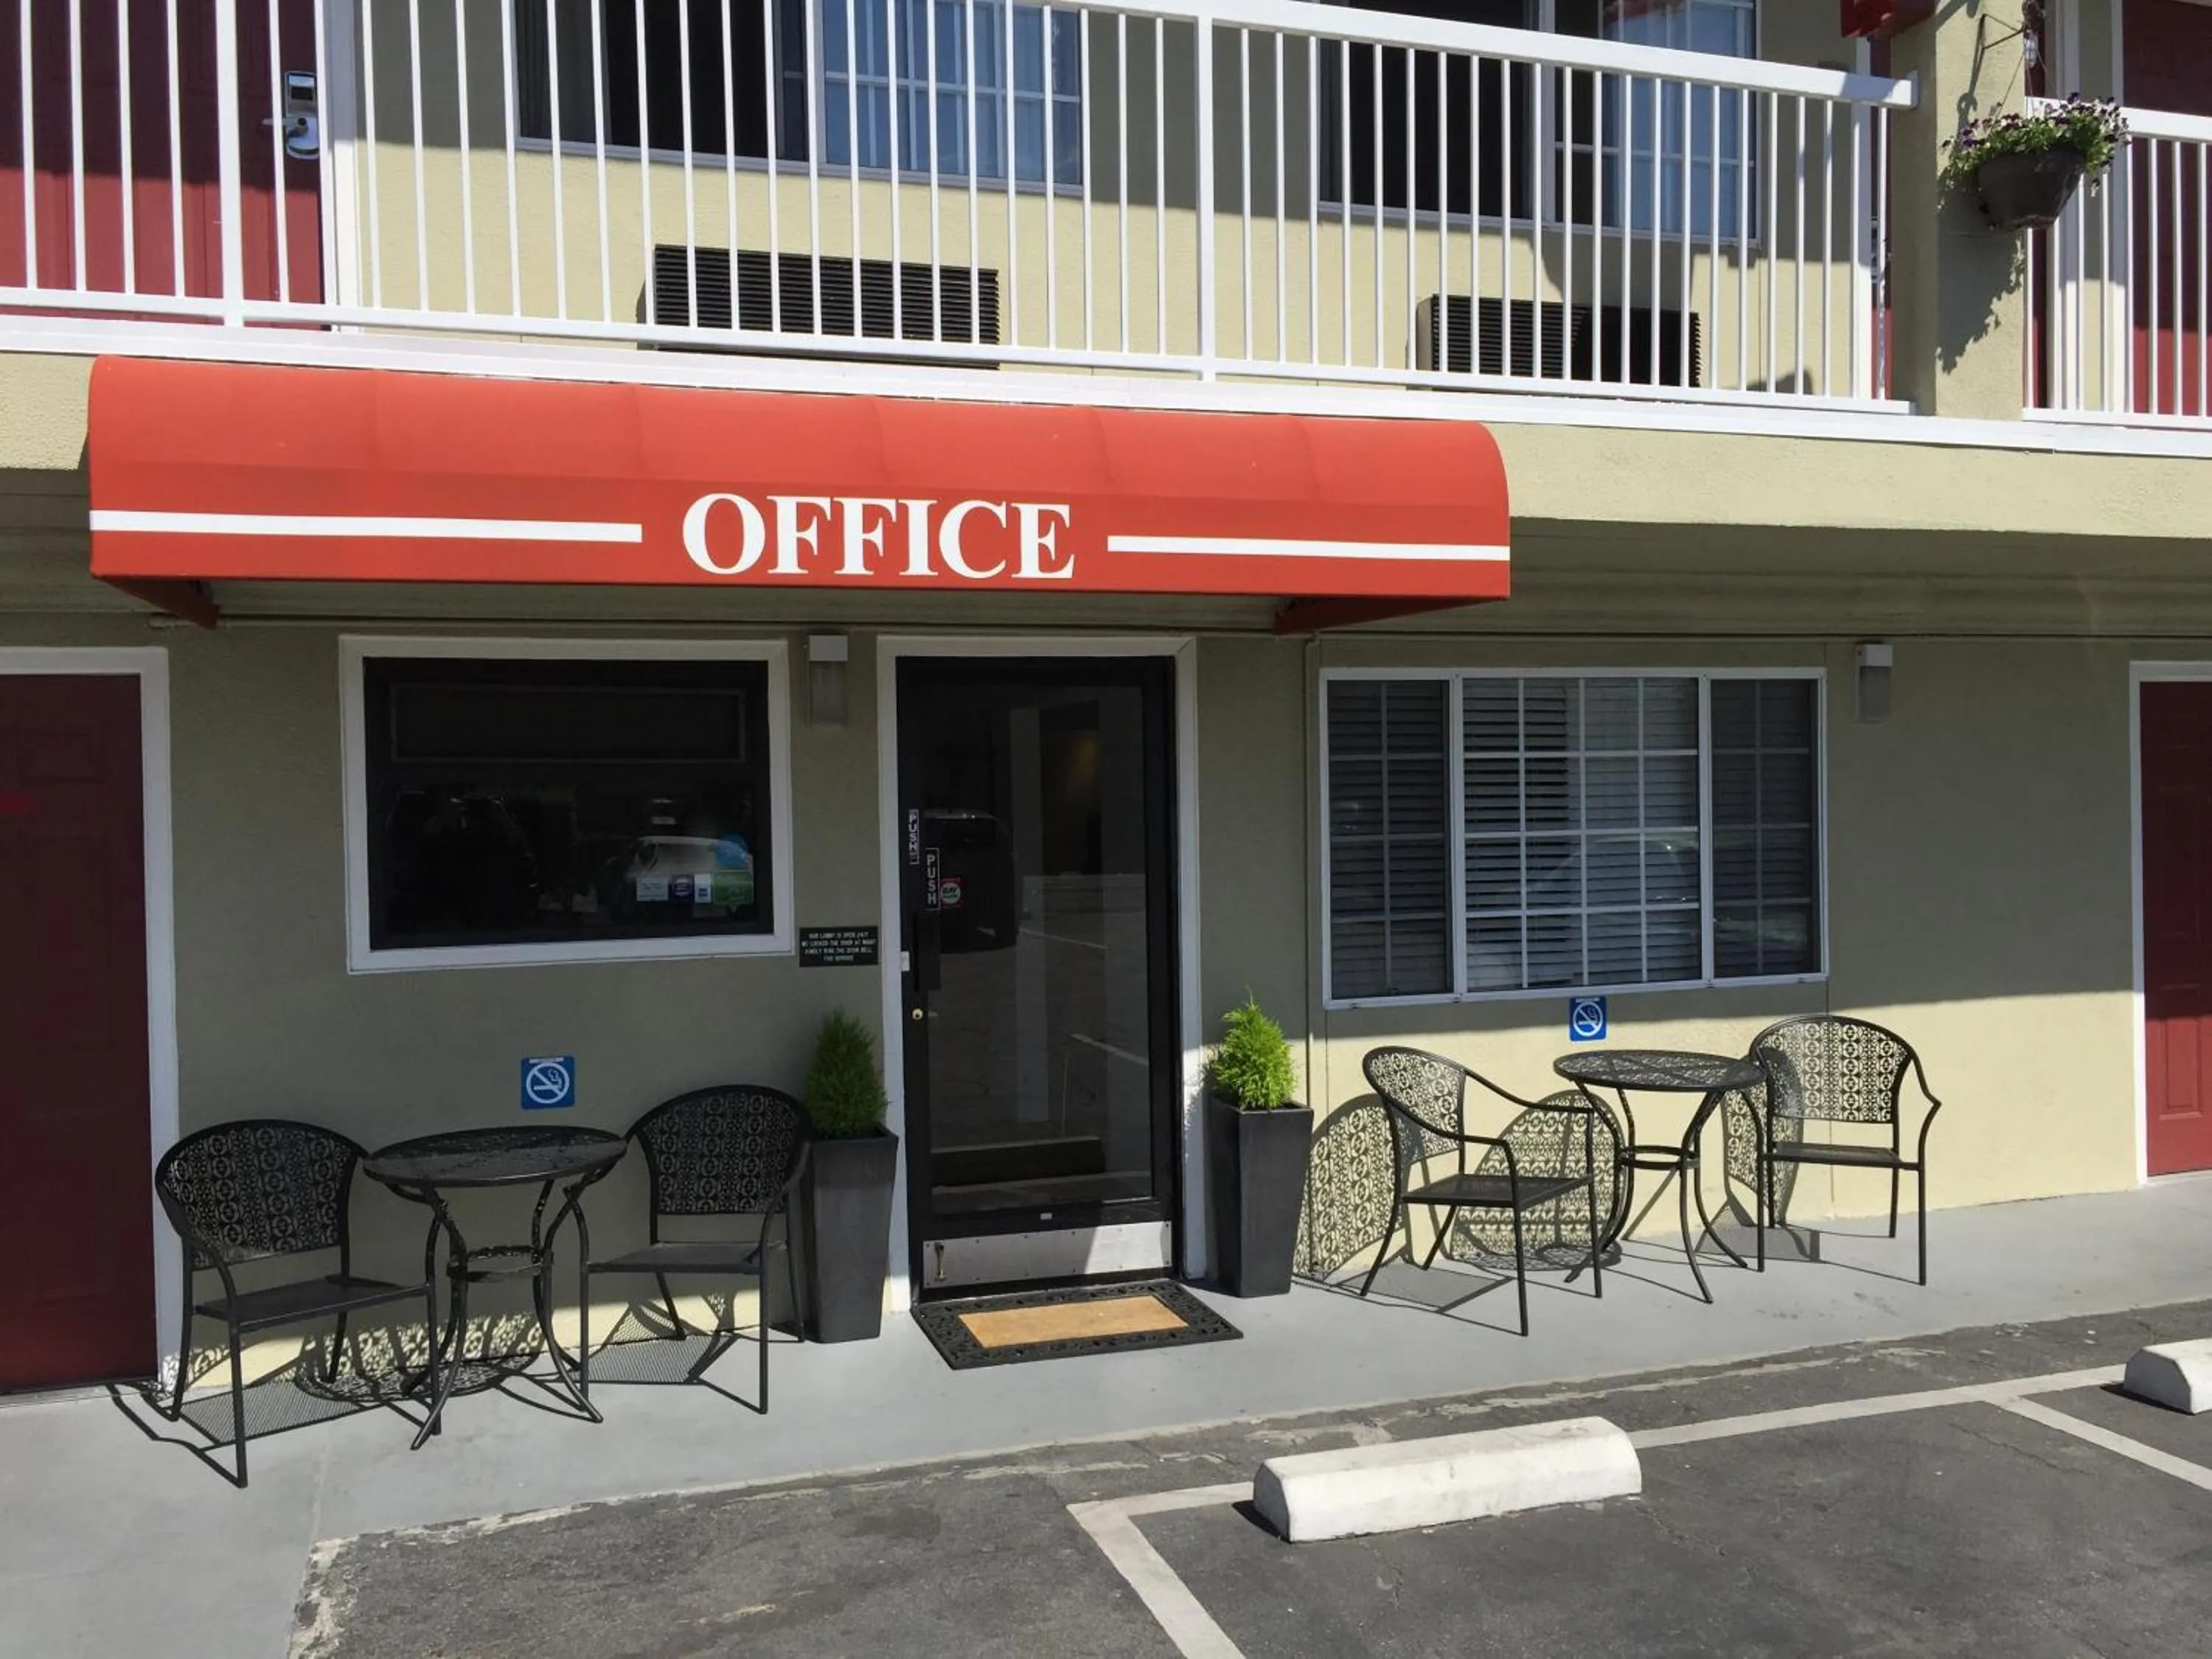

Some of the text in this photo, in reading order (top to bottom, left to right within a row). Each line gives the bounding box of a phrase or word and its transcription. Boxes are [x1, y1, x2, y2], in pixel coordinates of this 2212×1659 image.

[682, 493, 1075, 580] OFFICE
[908, 813, 917, 850] PUSH
[927, 854, 936, 905] PUSH
